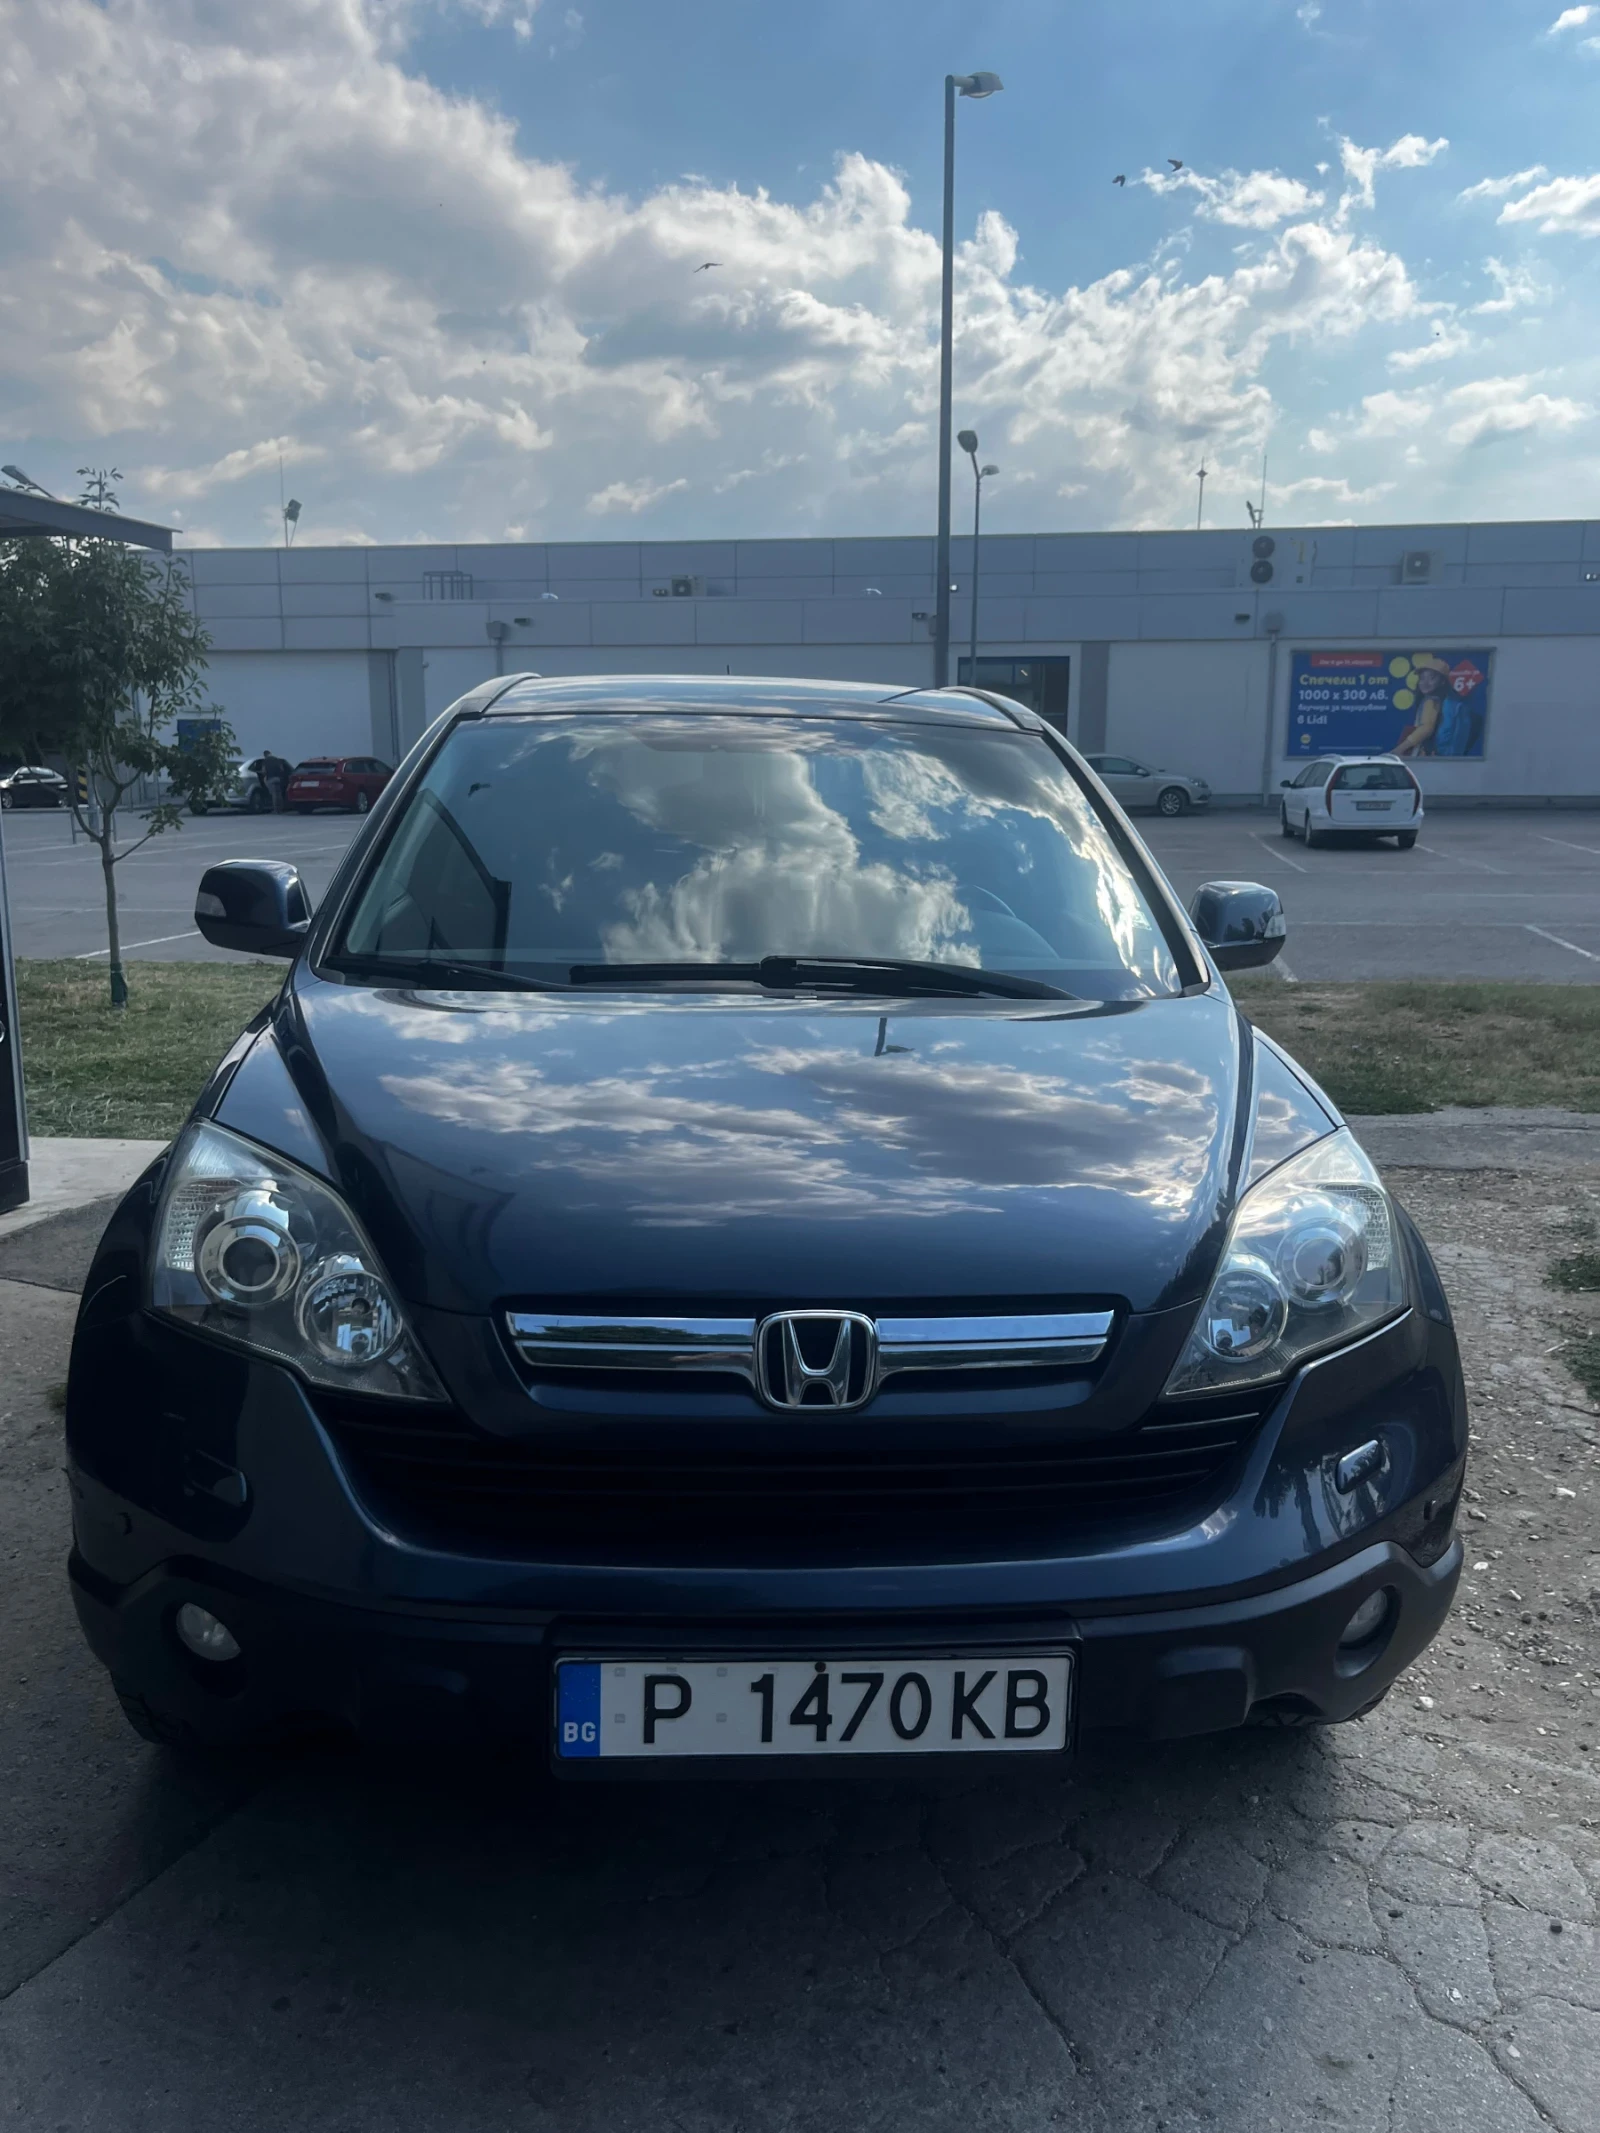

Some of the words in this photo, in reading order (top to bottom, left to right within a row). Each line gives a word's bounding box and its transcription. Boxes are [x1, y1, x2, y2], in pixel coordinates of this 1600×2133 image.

[1299, 673, 1356, 685] Спечели
[1359, 673, 1365, 685] 1
[1367, 676, 1389, 685] от
[1453, 676, 1476, 692] 6+
[1298, 689, 1330, 700] 1000
[1342, 689, 1367, 700] 300
[1369, 689, 1389, 700] лв.
[1306, 714, 1328, 725] Lidl
[643, 1673, 692, 1744] P
[750, 1671, 932, 1743] 1470
[950, 1669, 1051, 1740] KB
[564, 1721, 597, 1743] BG
